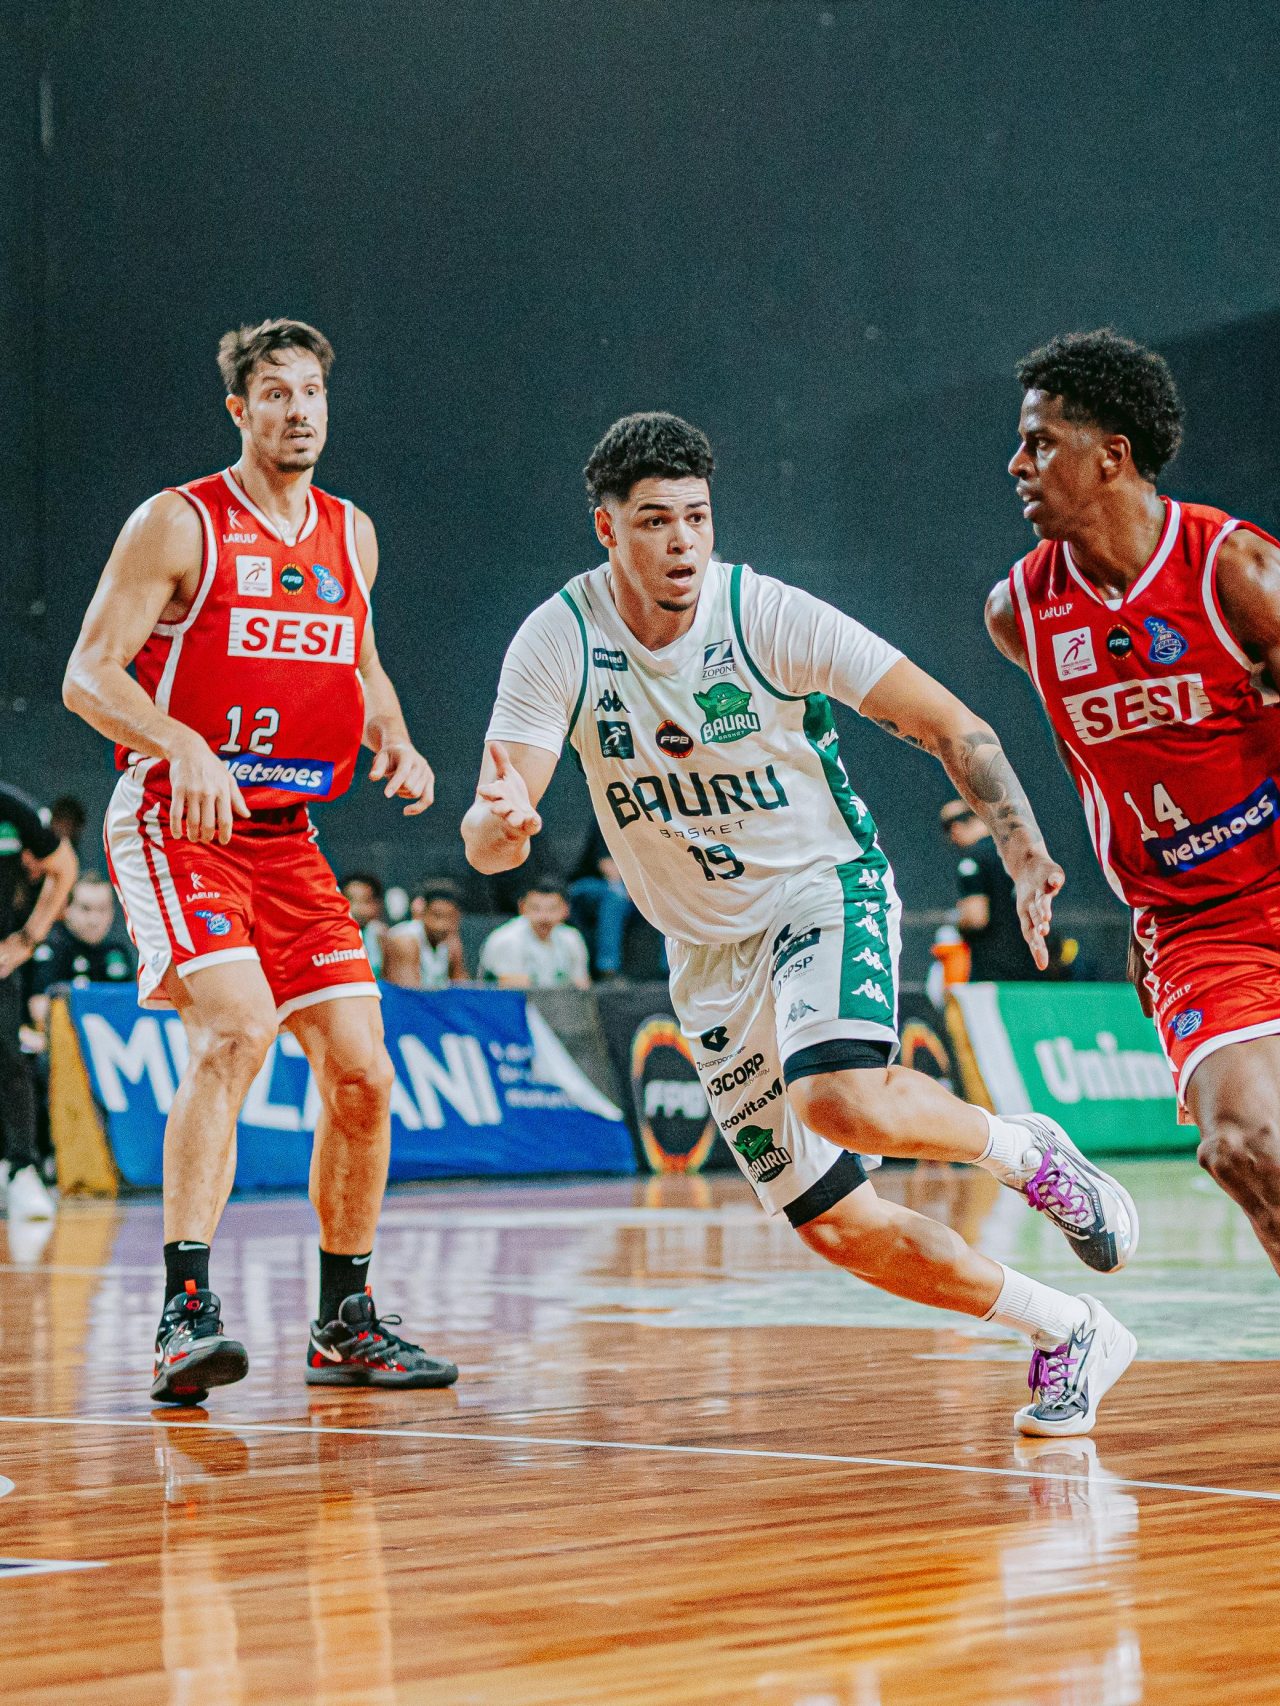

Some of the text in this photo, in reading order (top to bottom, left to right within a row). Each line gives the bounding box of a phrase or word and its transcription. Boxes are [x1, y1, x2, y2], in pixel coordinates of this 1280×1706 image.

[281, 574, 302, 584] FPB
[1039, 603, 1073, 620] LARULP
[242, 616, 344, 657] SESI
[1109, 637, 1130, 648] FPB
[702, 663, 737, 678] ZOPONE
[1081, 680, 1193, 739] SESI
[218, 705, 280, 756] 12
[660, 735, 690, 745] FPB
[702, 713, 759, 742] BAURU
[605, 764, 790, 830] BAURU
[1123, 782, 1192, 842] 14
[659, 819, 745, 840] BASKET
[1162, 794, 1274, 867] Netshoes
[687, 843, 746, 882] 19
[720, 1096, 768, 1131] ecovita
